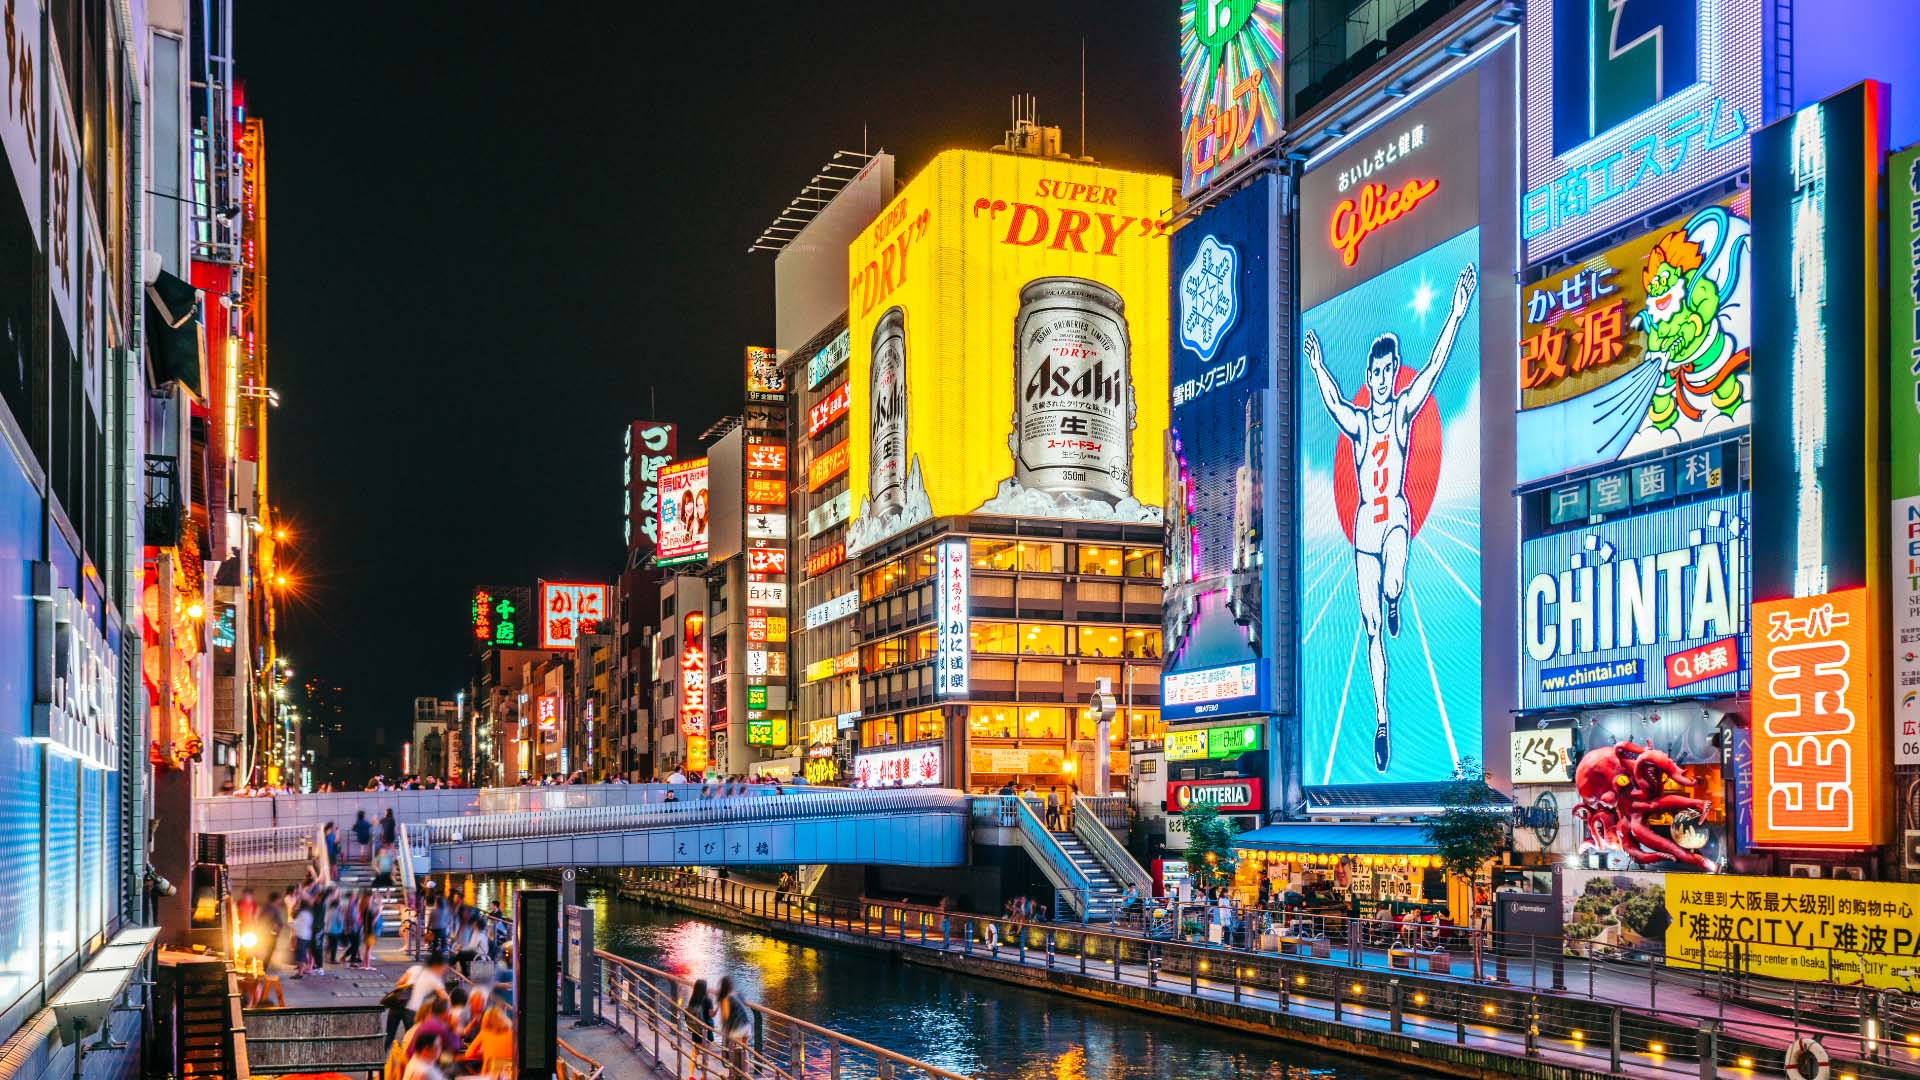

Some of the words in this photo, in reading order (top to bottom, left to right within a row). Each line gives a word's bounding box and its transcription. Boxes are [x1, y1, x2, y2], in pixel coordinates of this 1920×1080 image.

[1191, 69, 1262, 176] ピップ
[1338, 124, 1425, 192] おいしさと健康
[1523, 97, 1747, 240] 日商エステム
[1036, 178, 1118, 206] SUPER
[873, 198, 908, 249] SUPER
[1330, 179, 1440, 267] Glico
[1527, 267, 1614, 325] かぜに
[1519, 298, 1625, 390] 改源
[1025, 354, 1120, 408] Asahi
[1172, 355, 1246, 407] 雪印メグミルク
[1060, 415, 1089, 436] 生
[1047, 439, 1102, 453] スーパードライ
[1062, 470, 1086, 481] 350ml
[1372, 434, 1390, 524] グリコ
[1558, 452, 1711, 518] 戸堂歯科
[1709, 471, 1719, 486] 3F
[550, 590, 599, 614] かに
[750, 586, 783, 600] 白木屋
[1767, 603, 1850, 642] スーパー
[1693, 647, 1729, 675] 検索
[1722, 728, 1732, 763] 2F
[1764, 640, 1855, 832] 玉出
[1522, 737, 1560, 775] くくる
[1192, 785, 1244, 803] LOTTERIA
[678, 841, 769, 856] えびす橋
[1679, 890, 1914, 919] 从这里到大阪最大级别的购物中心
[1764, 954, 1789, 966] center
[1790, 955, 1798, 966] in
